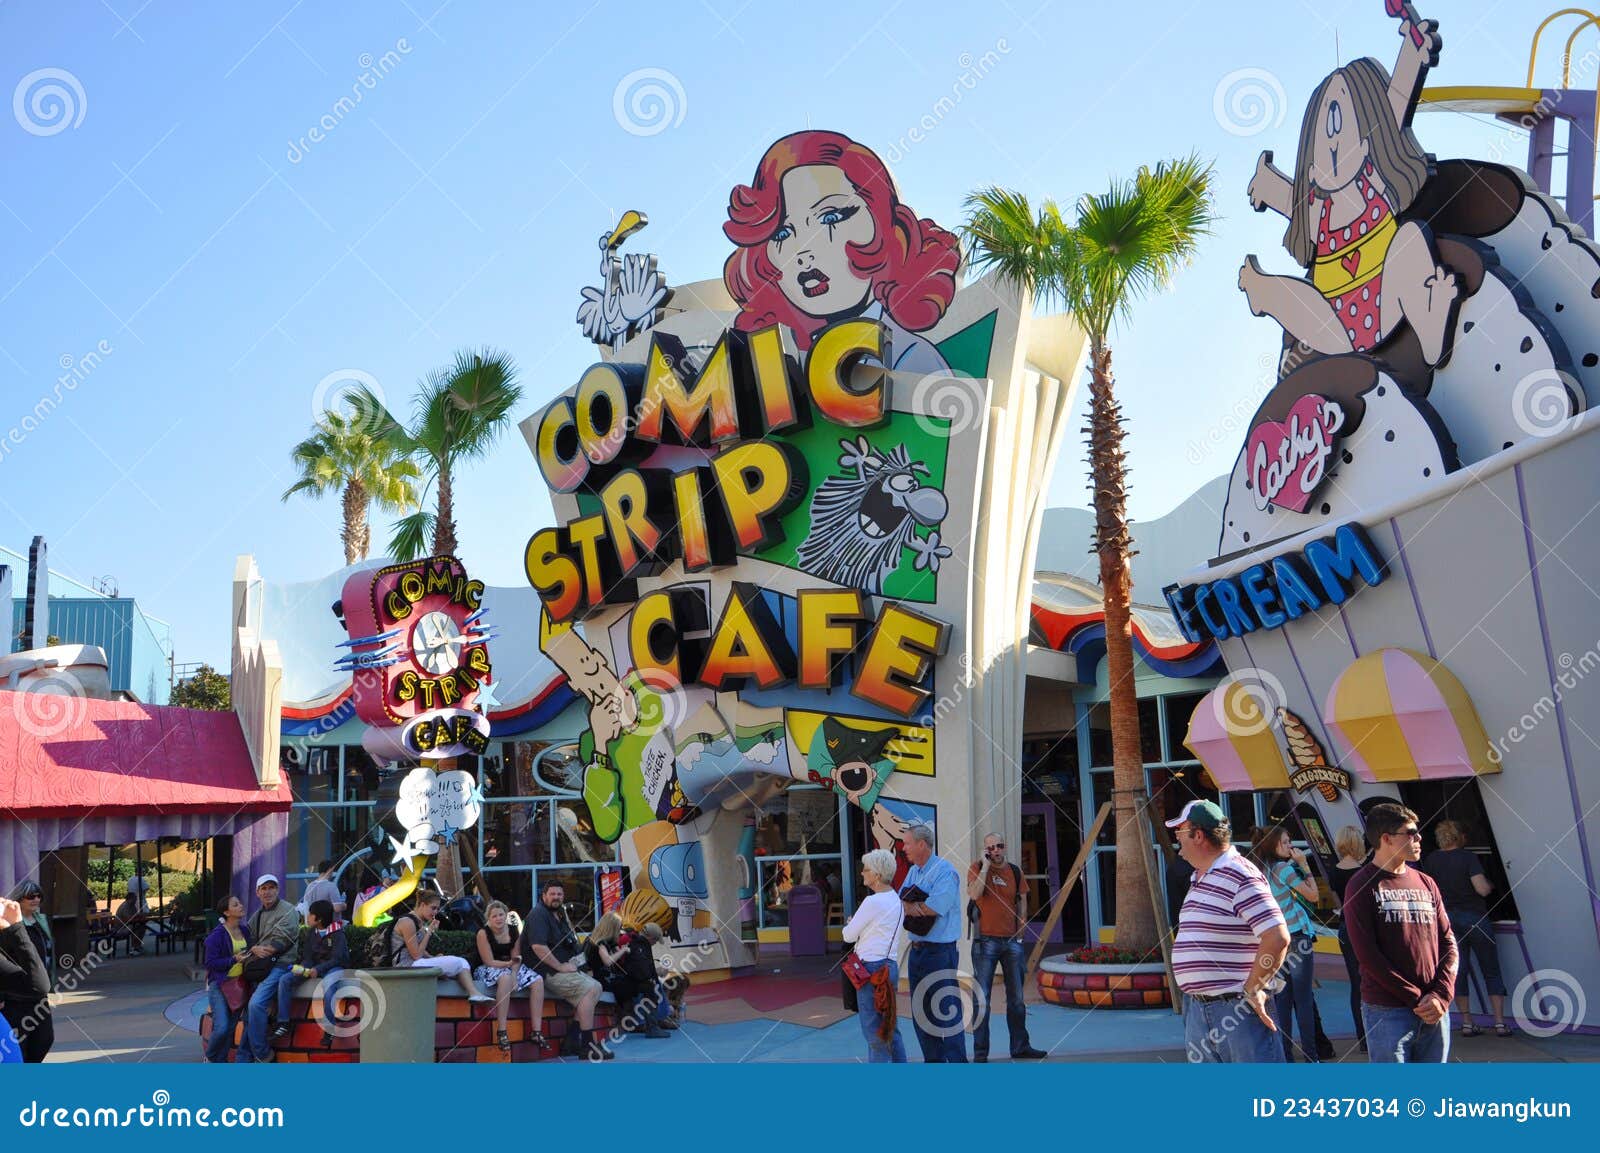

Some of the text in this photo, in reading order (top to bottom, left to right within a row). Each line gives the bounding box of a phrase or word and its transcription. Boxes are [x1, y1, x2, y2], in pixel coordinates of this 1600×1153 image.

[536, 319, 892, 494] COMIC
[1252, 401, 1346, 505] Cathy's
[524, 440, 805, 624] STRIP
[1194, 522, 1386, 641] CREAM
[386, 565, 485, 621] COMIC
[398, 647, 492, 709] STRIP
[627, 581, 952, 718] CAFE
[1384, 910, 1435, 925] ATHLETICS
